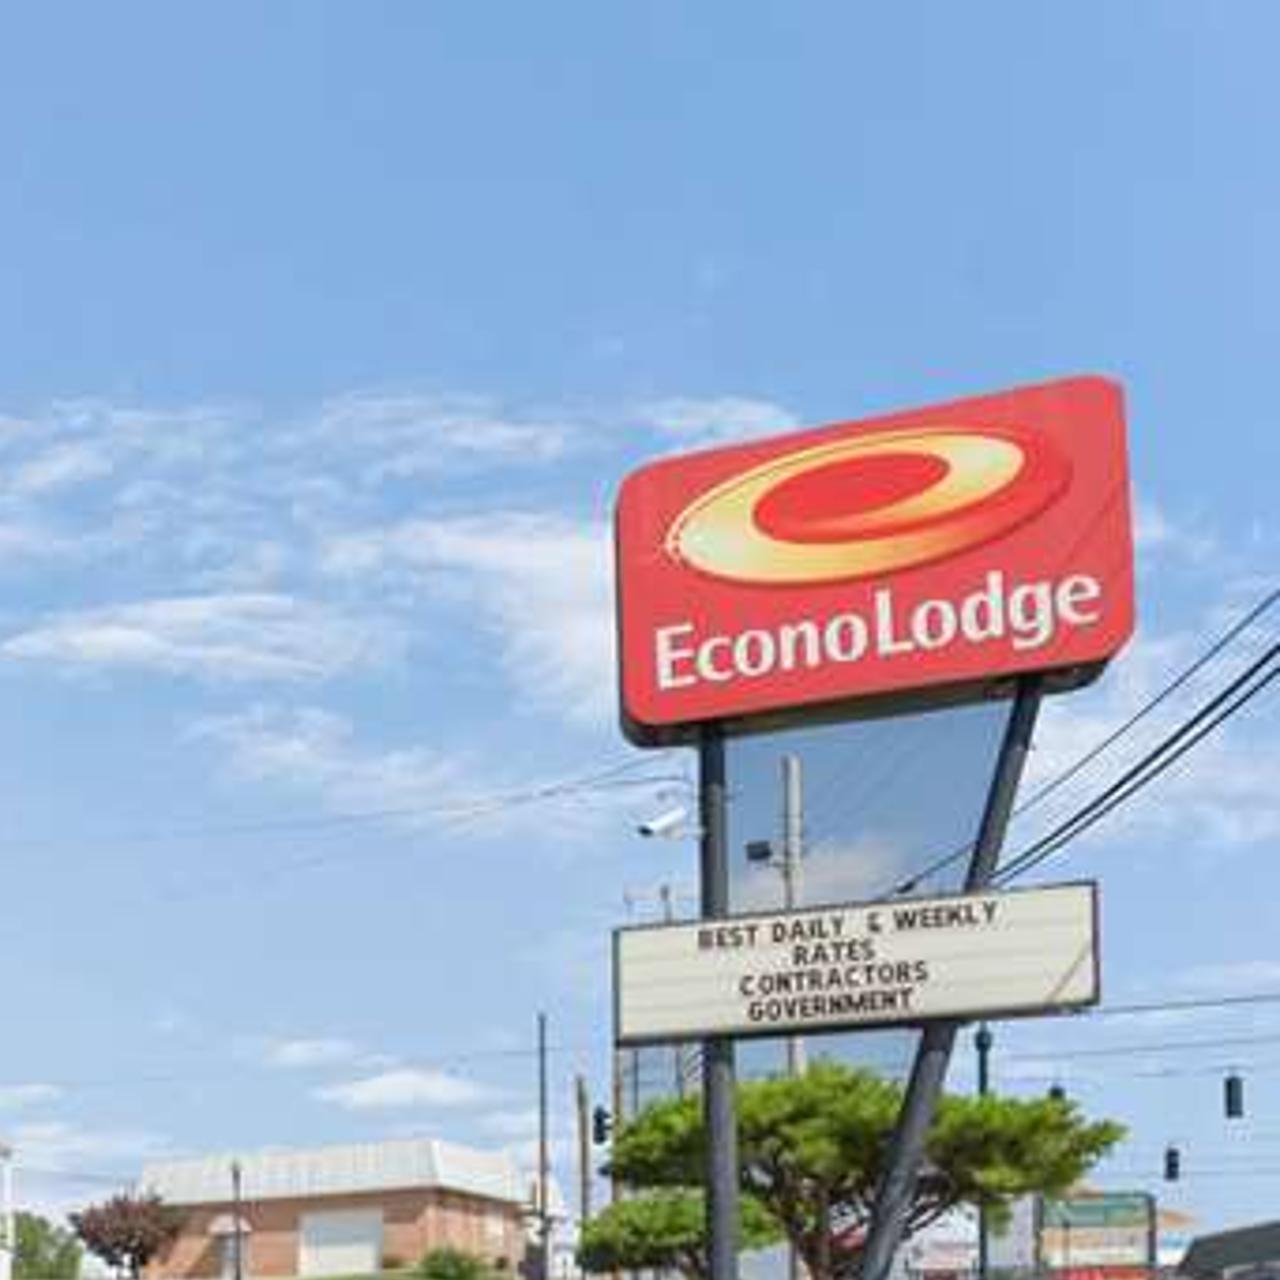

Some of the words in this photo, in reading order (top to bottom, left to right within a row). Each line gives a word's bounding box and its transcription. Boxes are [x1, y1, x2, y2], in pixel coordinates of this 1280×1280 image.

[698, 924, 758, 948] BEST
[772, 916, 844, 943] DAILY
[893, 901, 997, 930] WEEKLY
[793, 938, 876, 965] RATES
[740, 960, 929, 996] CONTRACTORS
[748, 987, 914, 1022] GOVERNMENT
